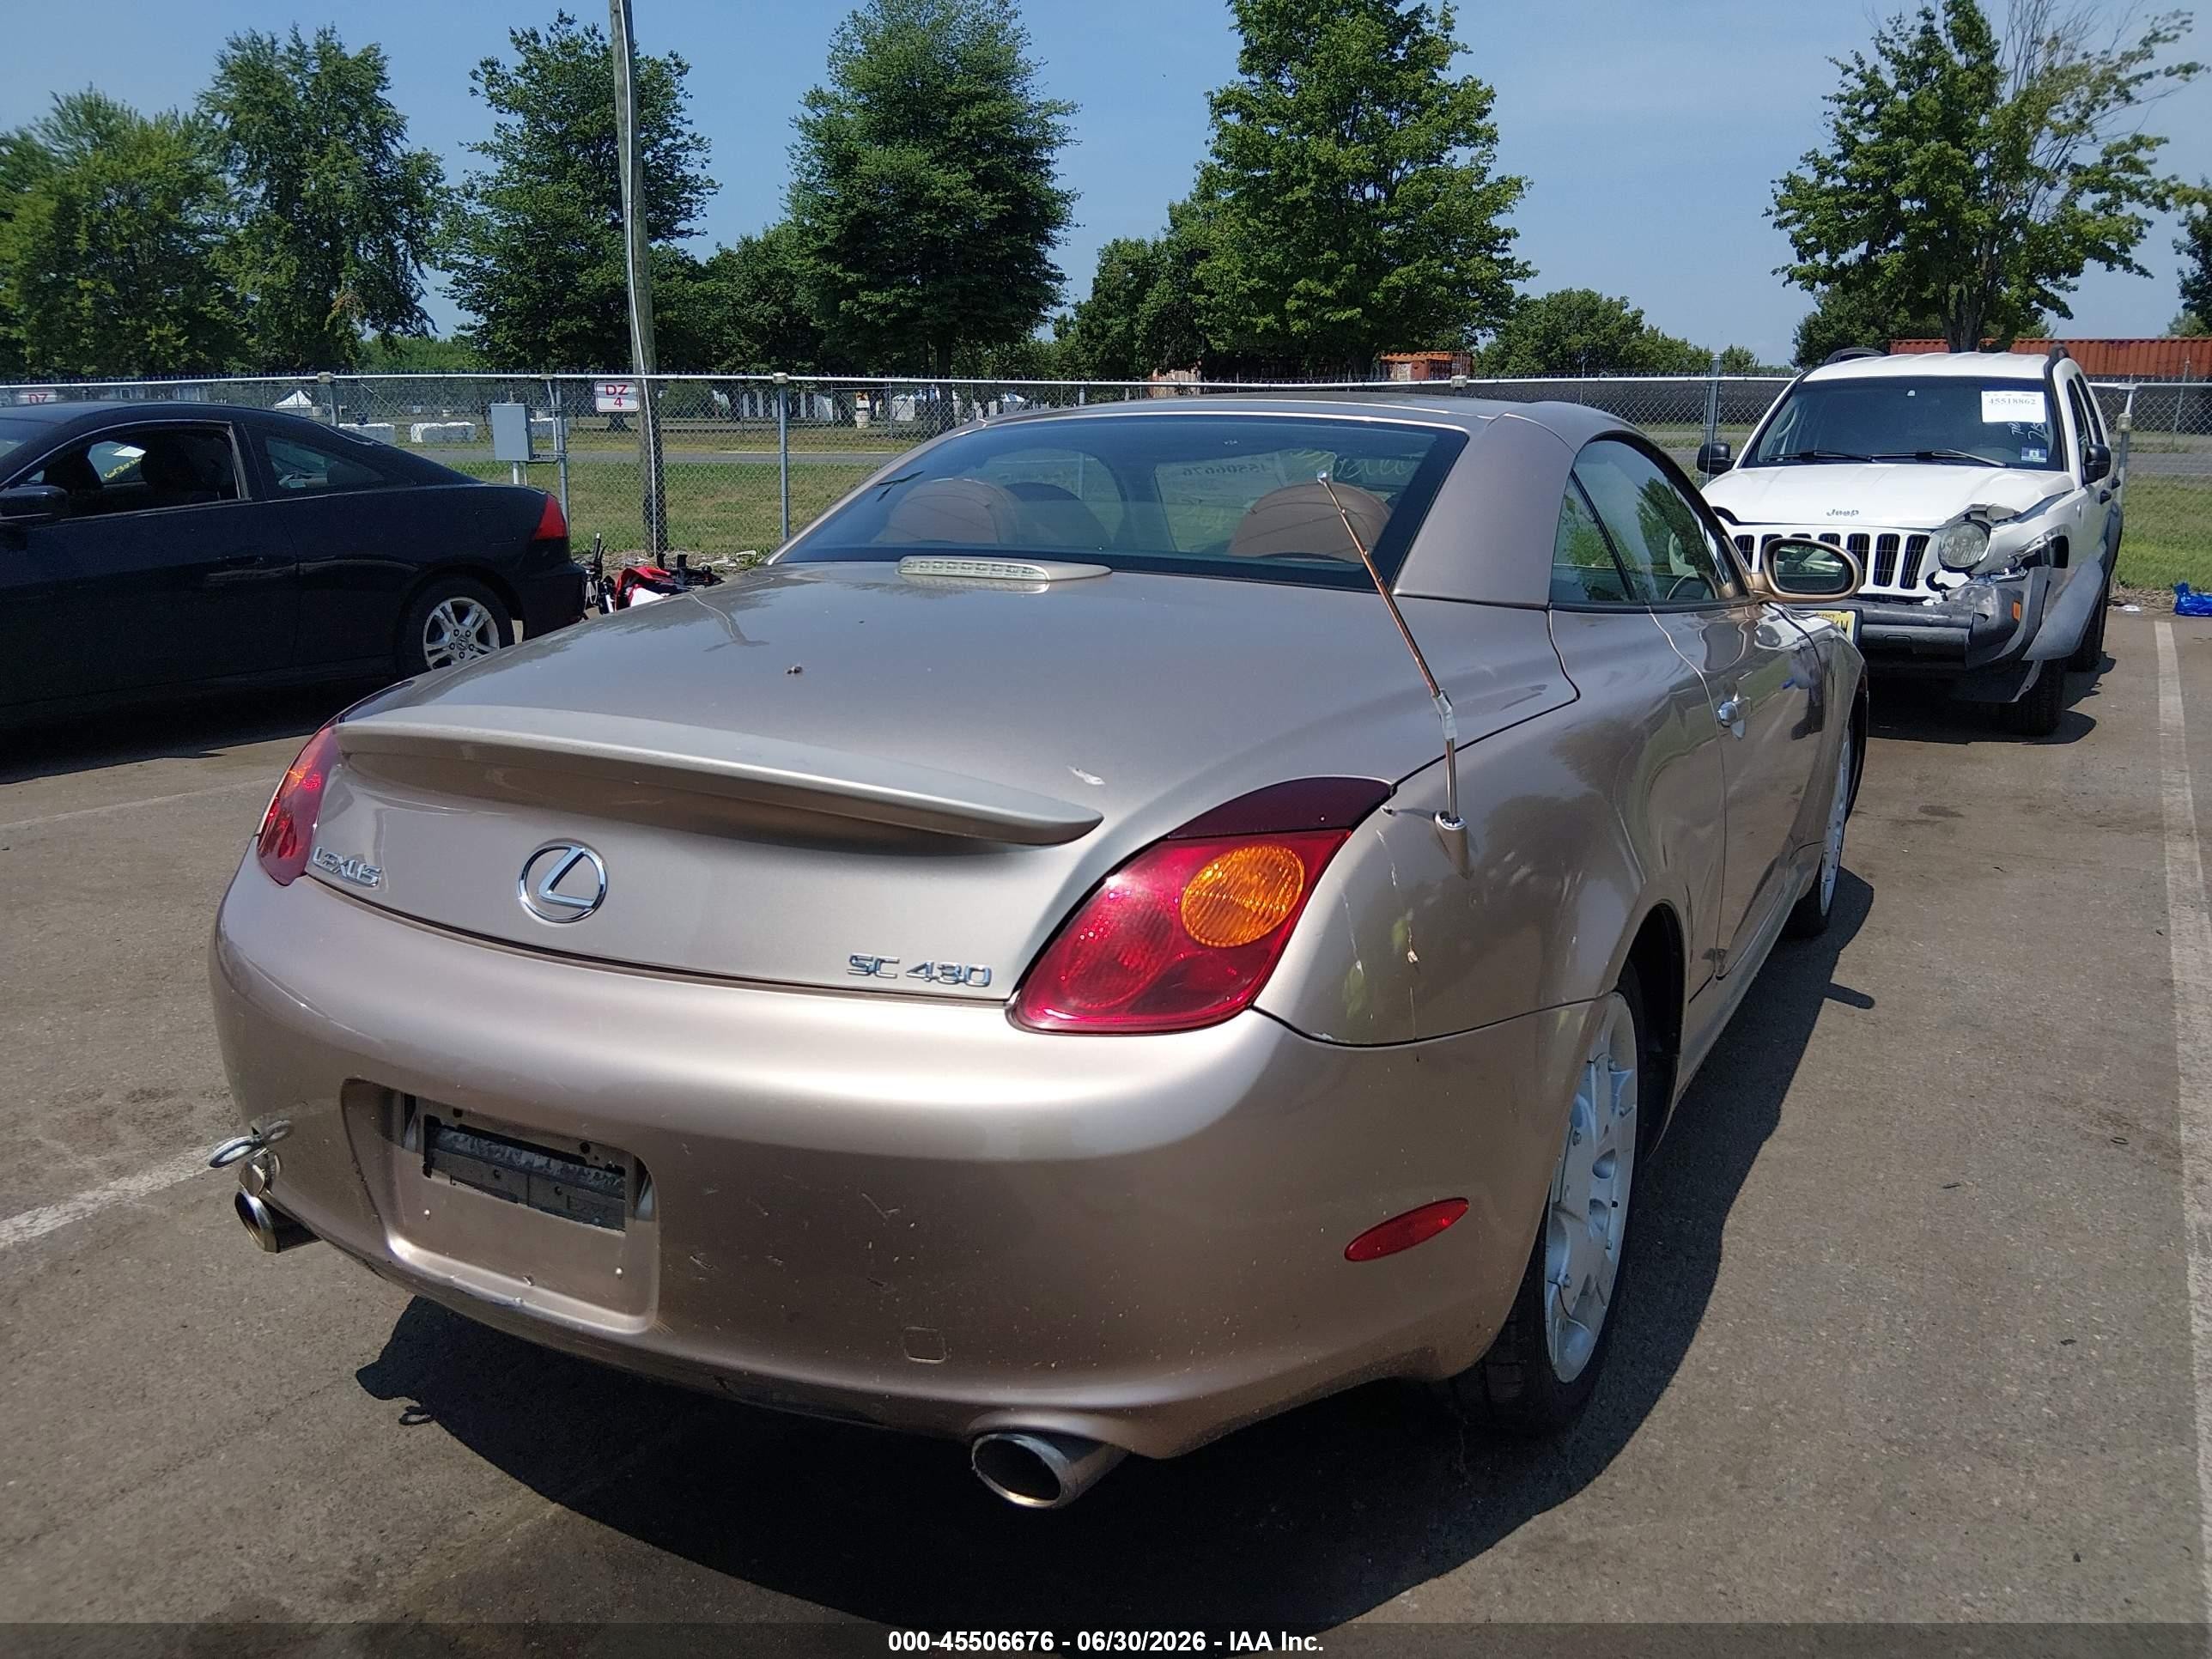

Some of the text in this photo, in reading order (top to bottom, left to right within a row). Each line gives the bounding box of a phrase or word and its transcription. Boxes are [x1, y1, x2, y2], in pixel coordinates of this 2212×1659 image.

[605, 384, 629, 396] DZ
[613, 397, 623, 408] 4
[313, 846, 382, 887] LEXUS
[847, 952, 993, 988] SC 430
